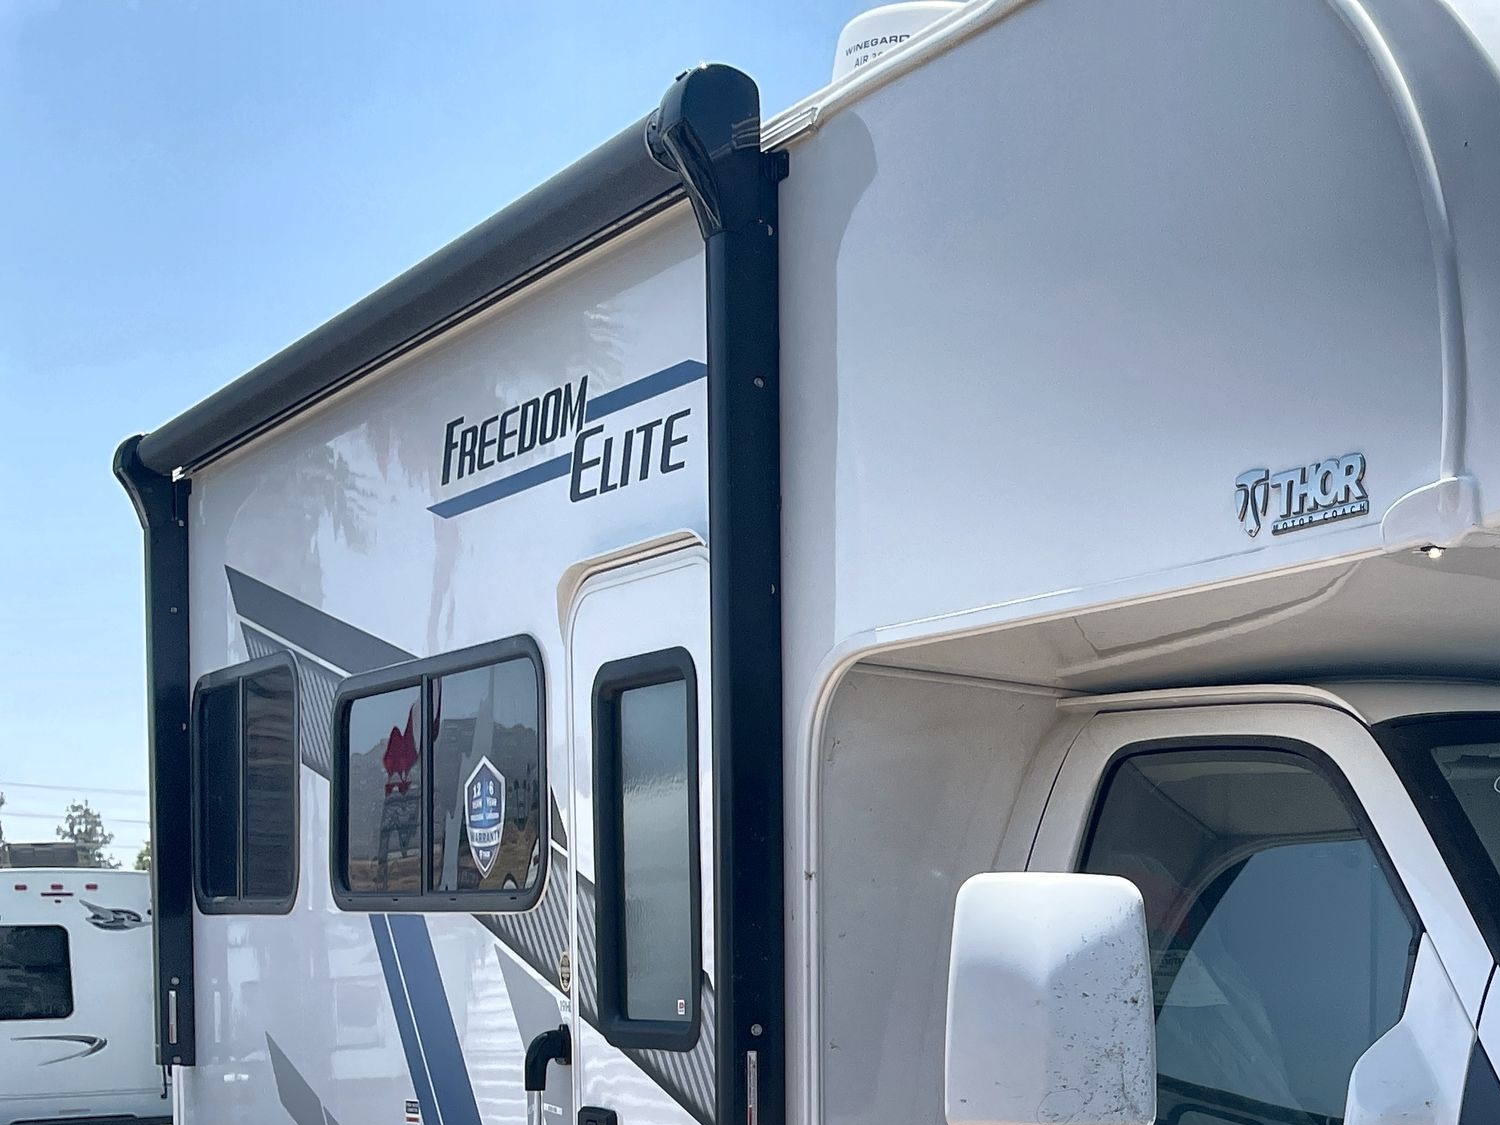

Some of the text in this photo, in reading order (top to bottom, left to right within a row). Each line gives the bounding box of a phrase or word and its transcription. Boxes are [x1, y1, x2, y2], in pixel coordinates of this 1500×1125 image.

[441, 375, 588, 486] FREEDOM
[570, 408, 691, 502] ELITE
[1271, 452, 1368, 518] THOR
[1272, 503, 1366, 531] MOTOR COACH
